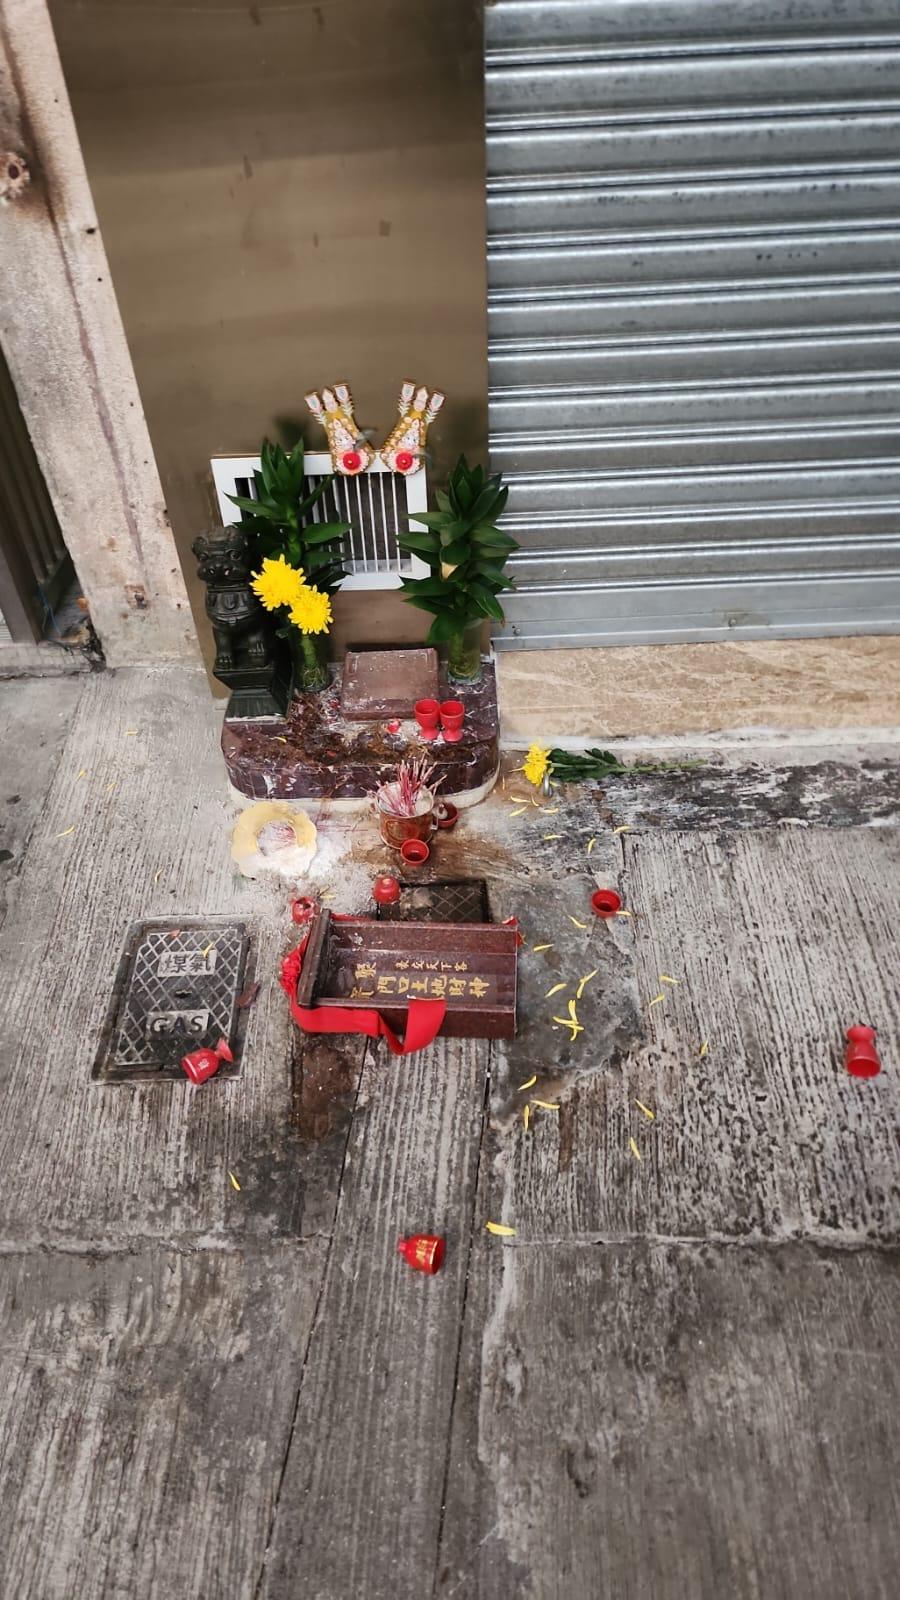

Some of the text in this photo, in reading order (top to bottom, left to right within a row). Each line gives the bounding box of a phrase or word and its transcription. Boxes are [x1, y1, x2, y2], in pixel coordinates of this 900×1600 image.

[162, 953, 212, 973] 煤氣
[377, 975, 490, 998] 門口土地財神
[151, 1015, 204, 1035] GAS
